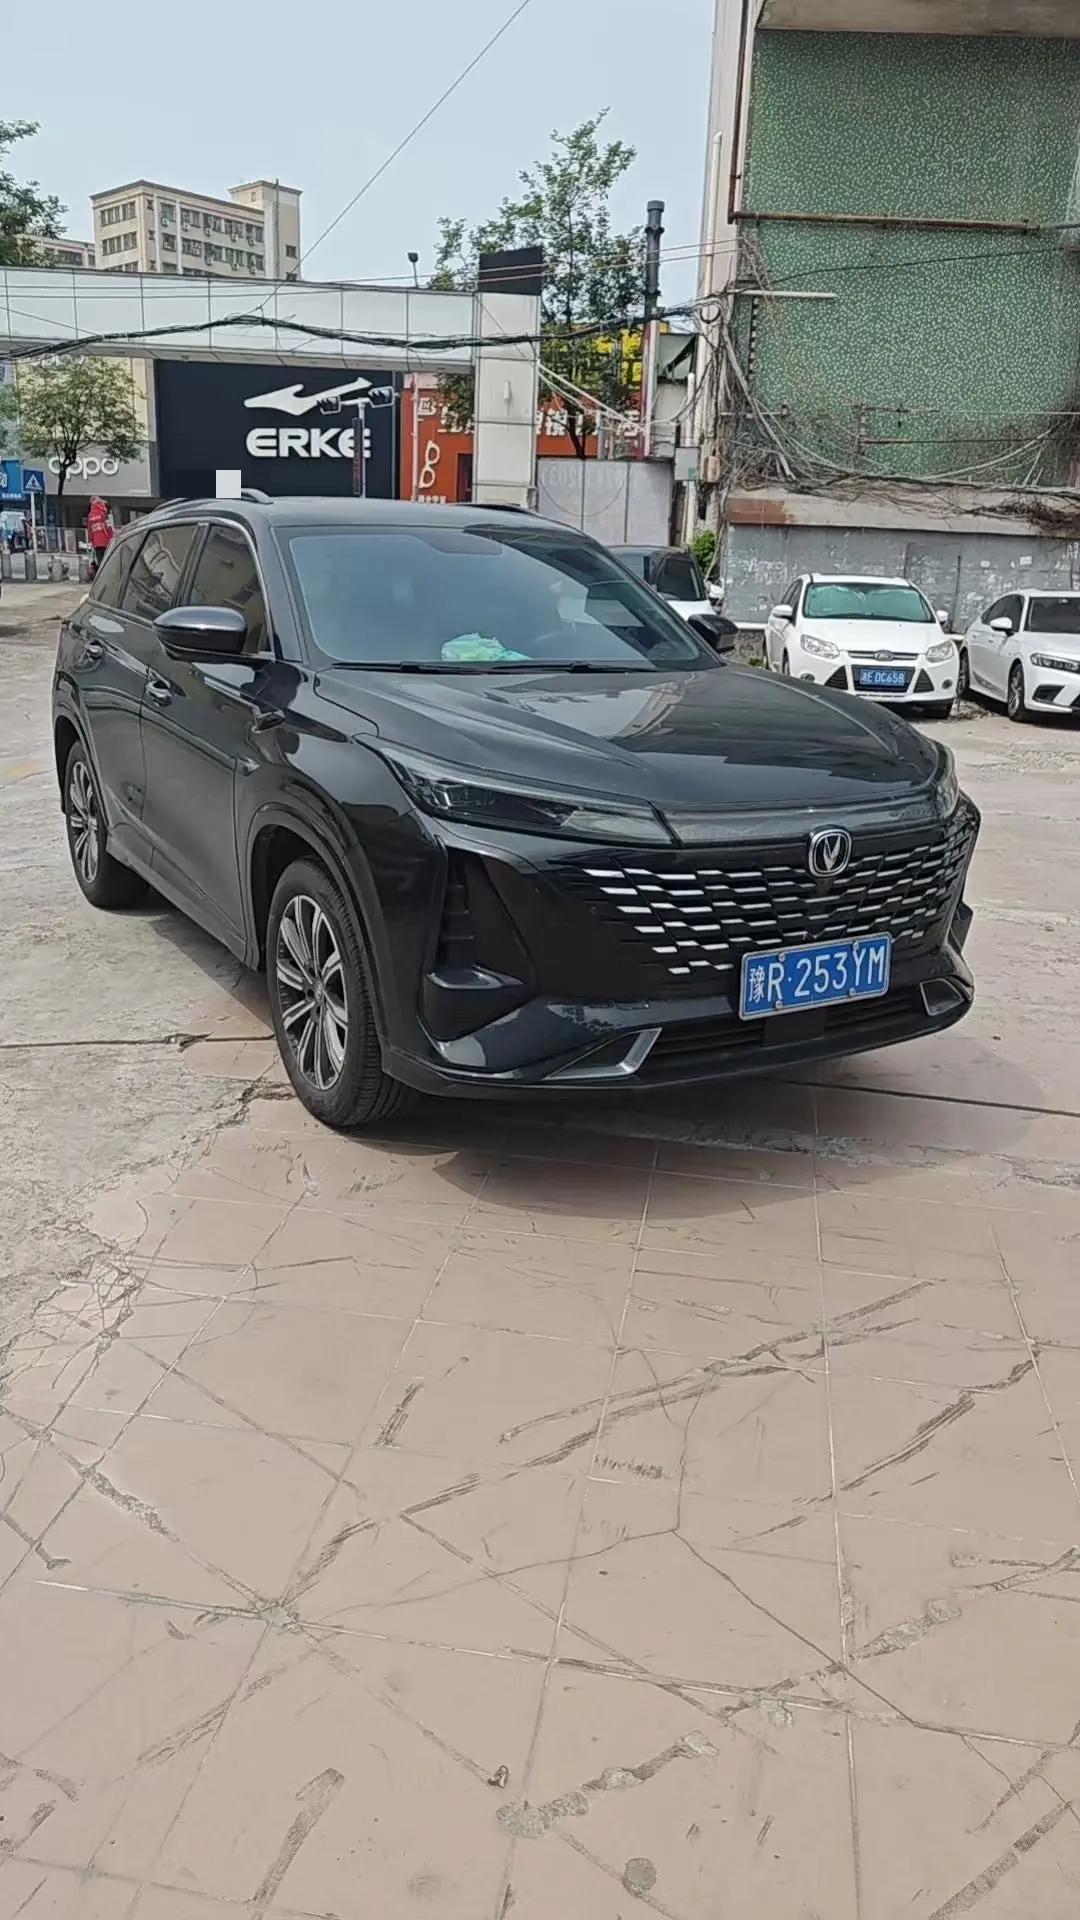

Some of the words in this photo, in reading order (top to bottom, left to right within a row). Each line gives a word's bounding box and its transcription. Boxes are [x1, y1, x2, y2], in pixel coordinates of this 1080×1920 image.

[246, 427, 371, 458] ERKE
[48, 456, 119, 479] oppo
[749, 945, 885, 1004] 豫R·253YM
